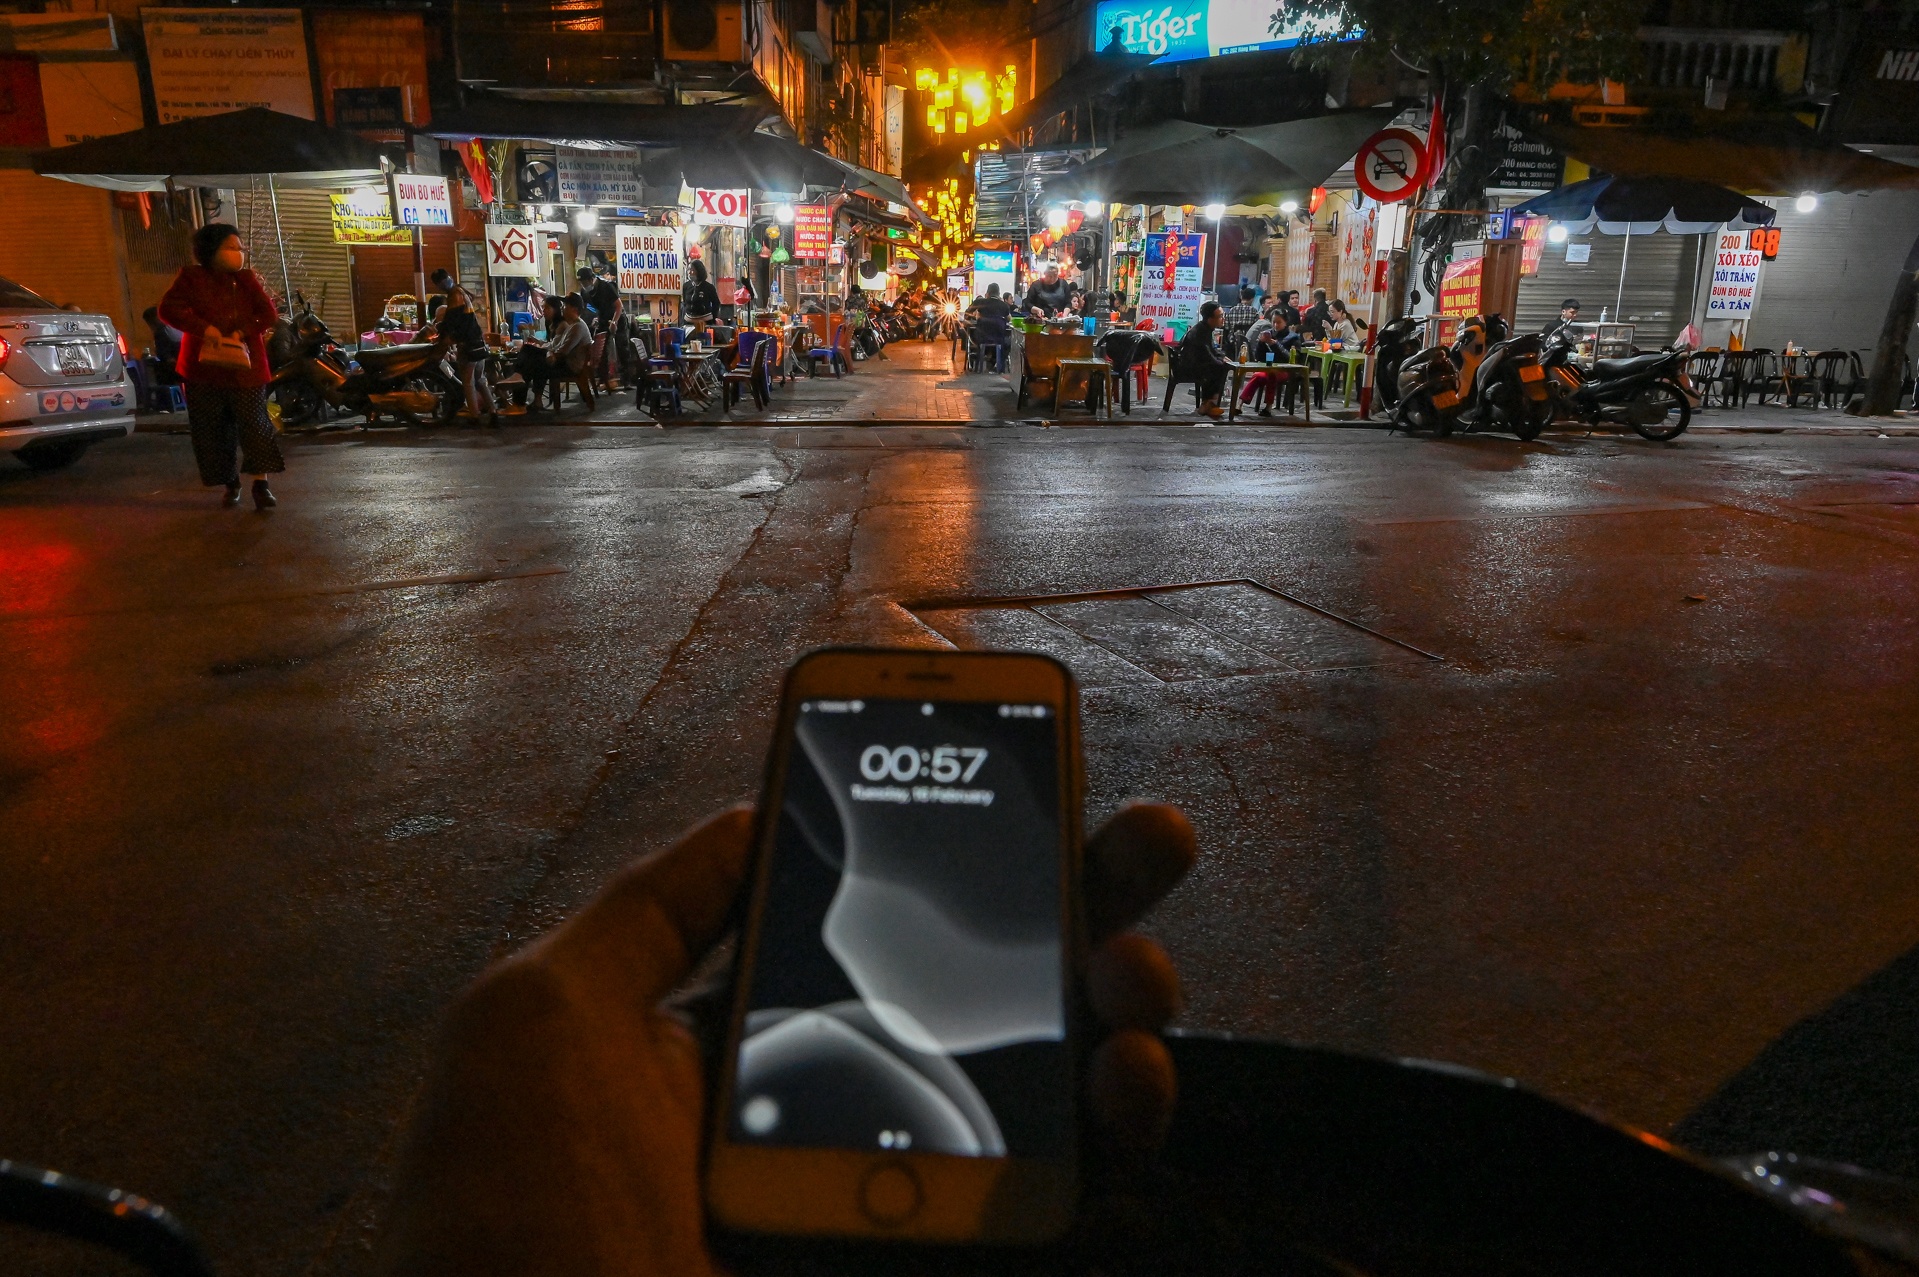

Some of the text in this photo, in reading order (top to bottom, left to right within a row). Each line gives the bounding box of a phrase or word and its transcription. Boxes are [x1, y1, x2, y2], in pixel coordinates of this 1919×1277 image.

[1121, 5, 1203, 55] Tiger
[1171, 39, 1187, 47] 1932
[1877, 49, 1919, 81] NH
[1507, 140, 1541, 153] Fashion
[1500, 158, 1516, 168] 200
[561, 181, 576, 191] CÁC
[622, 182, 637, 193] XÀO
[334, 203, 351, 217] CHO
[623, 233, 641, 251] BÚN
[644, 233, 655, 251] BÒ
[1720, 235, 1741, 250] 200
[1158, 240, 1197, 262] Ter
[621, 251, 645, 269] CHÁO
[647, 250, 659, 269] GÀ
[1717, 251, 1760, 267] XÔI XÉO
[620, 269, 681, 291] XÔI CƠM RANG
[1148, 267, 1164, 280] XÔ
[1714, 267, 1756, 283] XÔI TRẮNG
[1712, 285, 1727, 296] BÚN
[1728, 285, 1738, 297] BÒ
[1443, 295, 1455, 308] MUA
[1455, 293, 1471, 307] MANG
[1710, 298, 1726, 310] GÀ
[1140, 302, 1173, 318] CƠM ĐẢO
[1462, 308, 1479, 319] SHIP
[859, 743, 990, 784] 00:57
[929, 787, 994, 807] February
